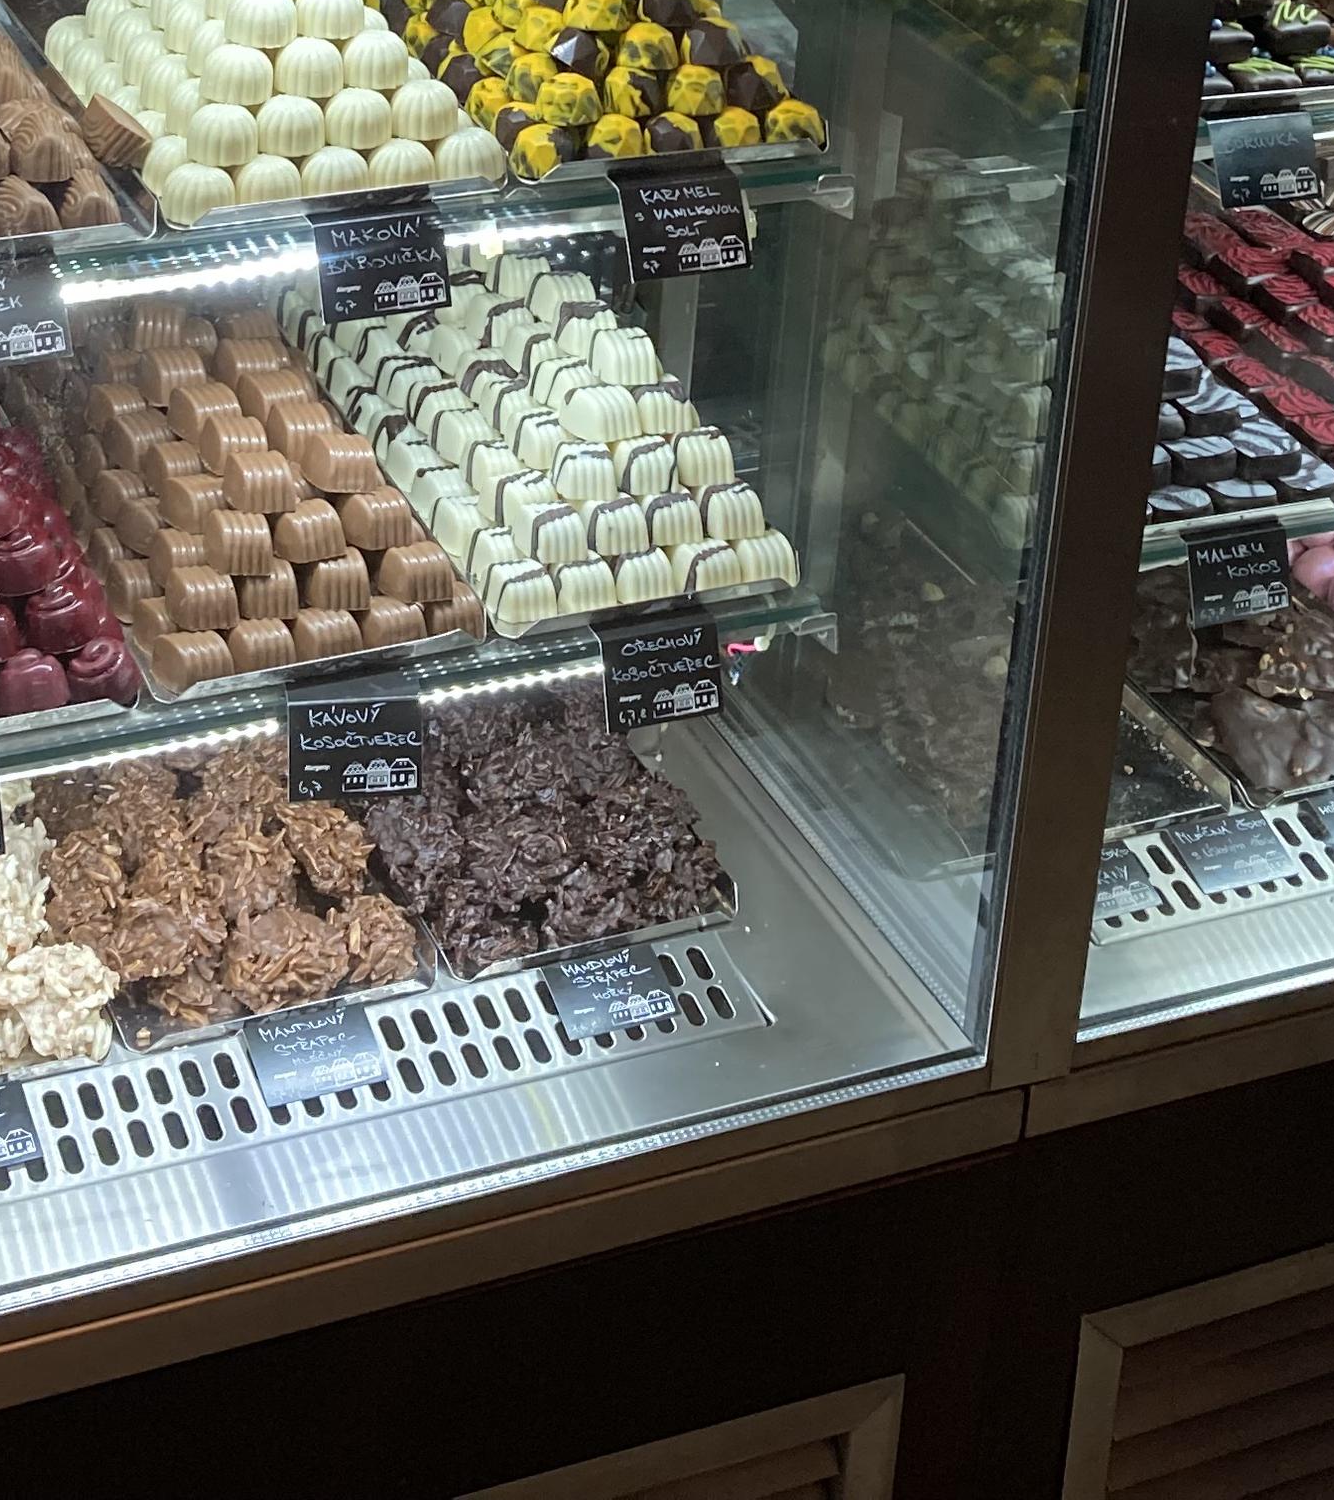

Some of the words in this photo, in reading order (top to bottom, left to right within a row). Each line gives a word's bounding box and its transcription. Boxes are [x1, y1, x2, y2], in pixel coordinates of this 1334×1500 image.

[638, 185, 723, 206] KARAMEL
[652, 204, 741, 222] VANILKOVOU
[330, 215, 422, 248] MAKOVÁ
[665, 219, 709, 239] SOLÍ
[1226, 558, 1282, 580] KOKOS
[611, 654, 723, 684] KOSOČTVEREC
[308, 702, 388, 729] KÁVOVÝ
[298, 730, 423, 752] KOSOČTVEREC
[560, 948, 631, 978] MANDLOVÝ
[572, 964, 653, 990] STŘAPEC
[258, 1006, 347, 1043] MANDLOVÝ
